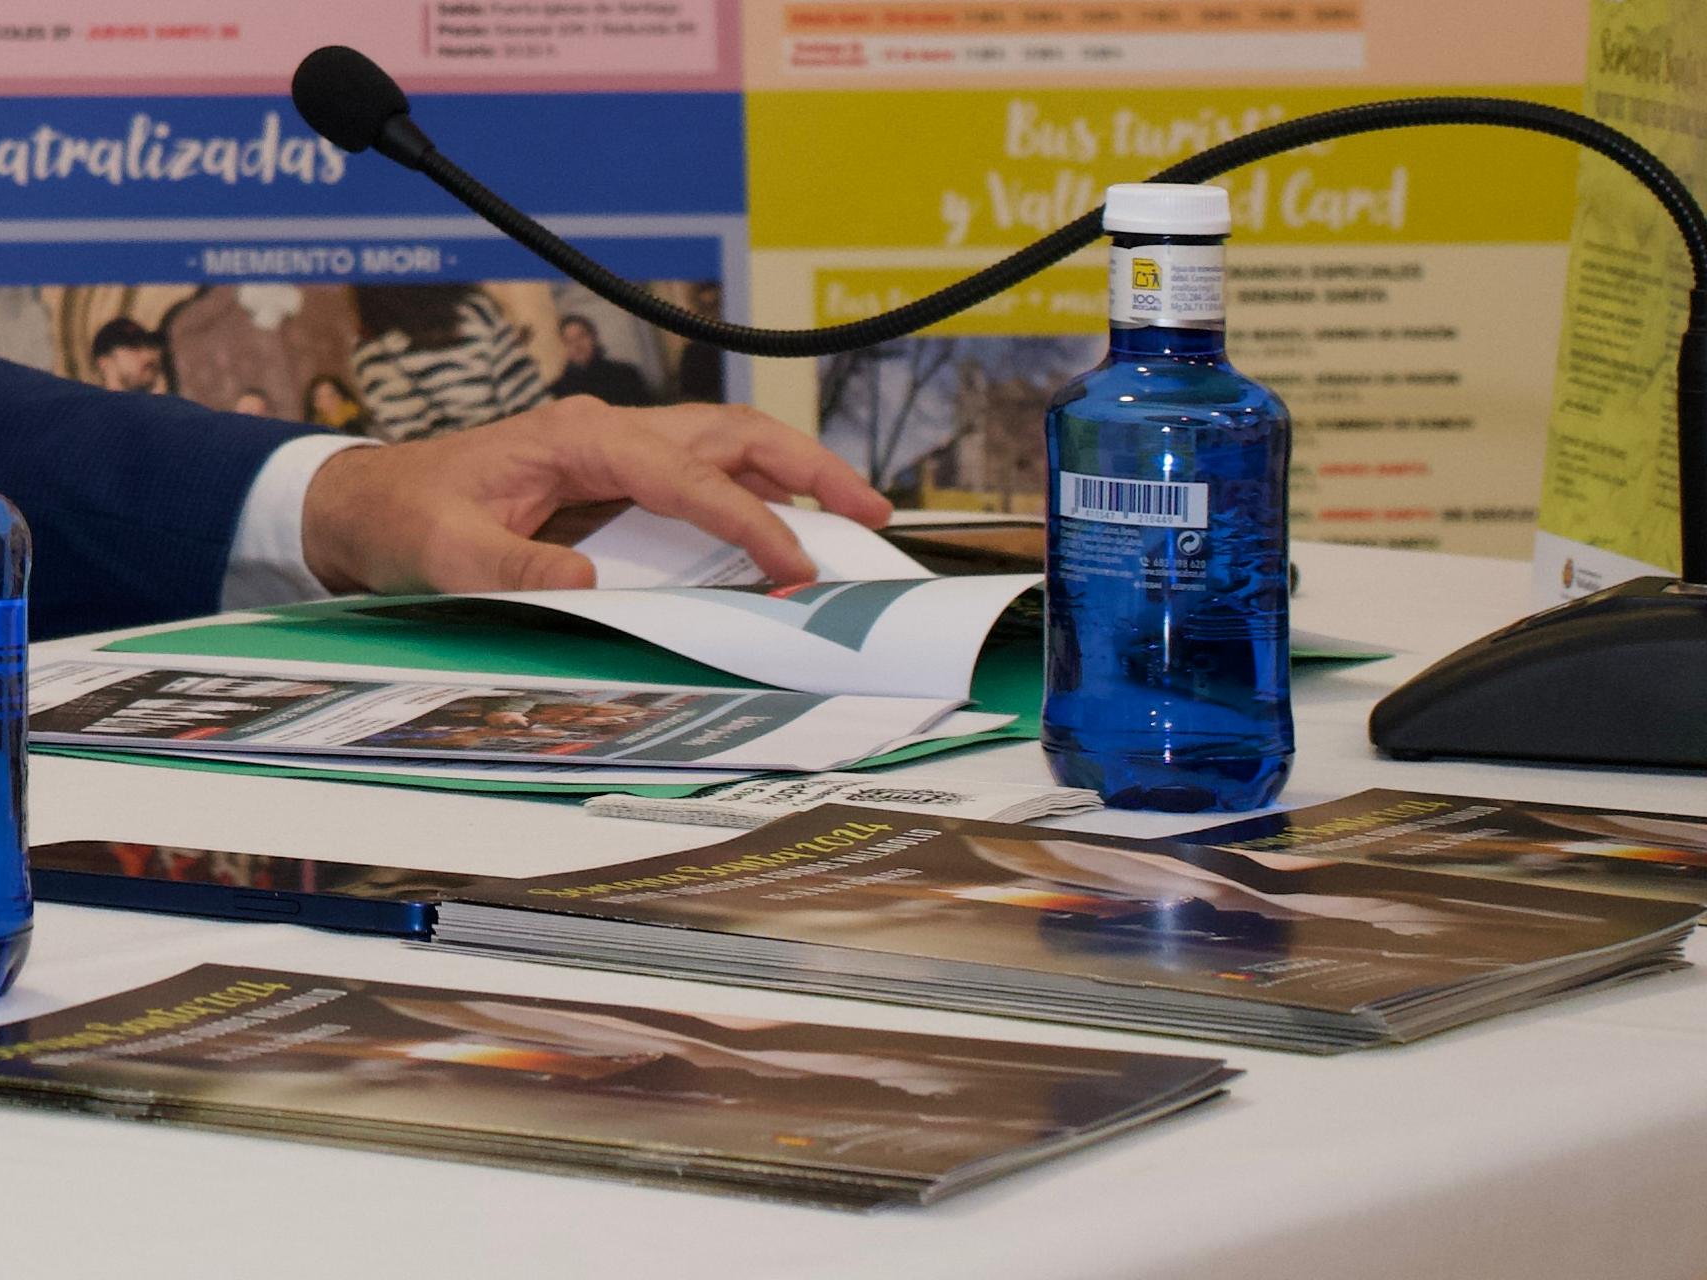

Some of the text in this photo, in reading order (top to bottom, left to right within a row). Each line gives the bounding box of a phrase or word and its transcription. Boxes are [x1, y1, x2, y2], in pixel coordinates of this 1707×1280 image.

[1003, 98, 1097, 162] Bus
[940, 189, 973, 247] y
[1280, 166, 1408, 232] Card
[201, 248, 442, 276] MEMENTO MORI
